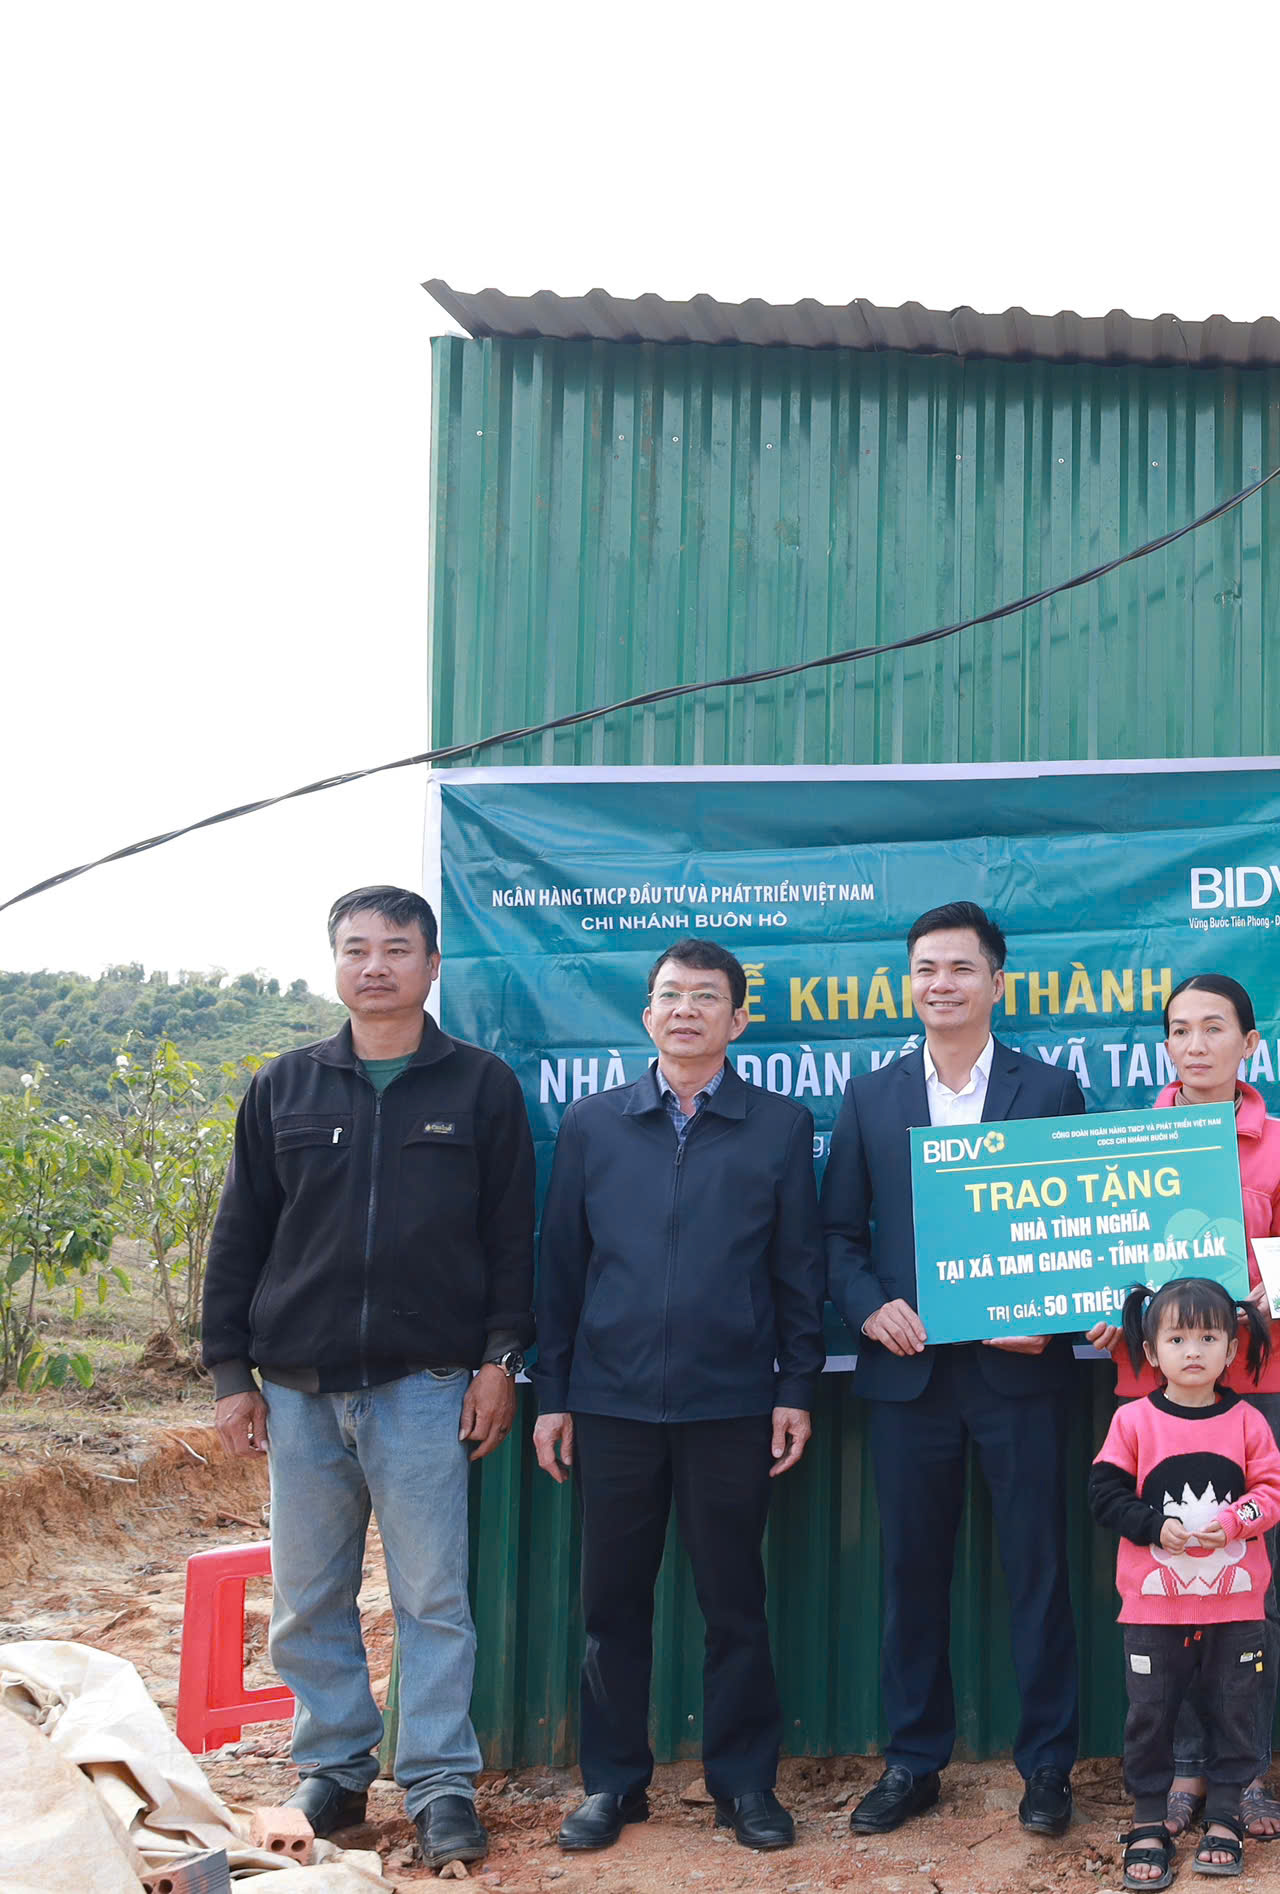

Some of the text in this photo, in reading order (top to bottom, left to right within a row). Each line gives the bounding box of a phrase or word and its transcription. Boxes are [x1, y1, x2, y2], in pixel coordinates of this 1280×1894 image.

[492, 879, 874, 907] NGÂN HÀNG TMCP ĐẦU TƯ VÀ PHÁT TRIỂN VIỆT NAM
[581, 917, 614, 930] CHI
[619, 913, 689, 930] NHÁNH
[695, 912, 753, 928] BUÔN
[1189, 917, 1209, 931] Vững
[1210, 916, 1230, 928] Bước
[1231, 915, 1246, 927] Tiên
[1247, 915, 1270, 929] Phong
[742, 961, 1172, 1022] Ễ KHÁ THÀNH
[539, 1049, 628, 1104] NHÀ
[736, 1046, 851, 1097] ĐOÀN
[1051, 1130, 1070, 1139] CÔNG
[1090, 1127, 1107, 1136] NGÂN
[1109, 1126, 1126, 1135] HÀNG
[1127, 1124, 1145, 1133] TMCP
[1146, 1122, 1155, 1131] VÀ
[1156, 1121, 1172, 1131] PHÁT
[1173, 1117, 1192, 1128] TRIỂN
[1192, 1118, 1206, 1128] VIỆT
[1207, 1117, 1222, 1126] NAM
[1127, 1133, 1149, 1143] NHÁNH
[1150, 1132, 1168, 1141] BUÔN
[923, 1136, 985, 1164] BIDV
[964, 1163, 1182, 1214] TRAO TẶNG
[1010, 1208, 1151, 1242] NHÀ TÌNH NGHĨA
[936, 1259, 965, 1284] TẠI
[969, 1254, 994, 1278] XÃ
[997, 1254, 1034, 1276] TAM
[1039, 1249, 1093, 1272] GIANG
[1108, 1240, 1150, 1266] TỈNH
[1153, 1234, 1189, 1262] ĐẮK
[1193, 1231, 1226, 1258] LẮK
[987, 1306, 1010, 1323] TRỊ
[1013, 1299, 1042, 1319] GIÁ:
[1044, 1294, 1067, 1316] 50
[1072, 1285, 1126, 1317] TRIỆU
